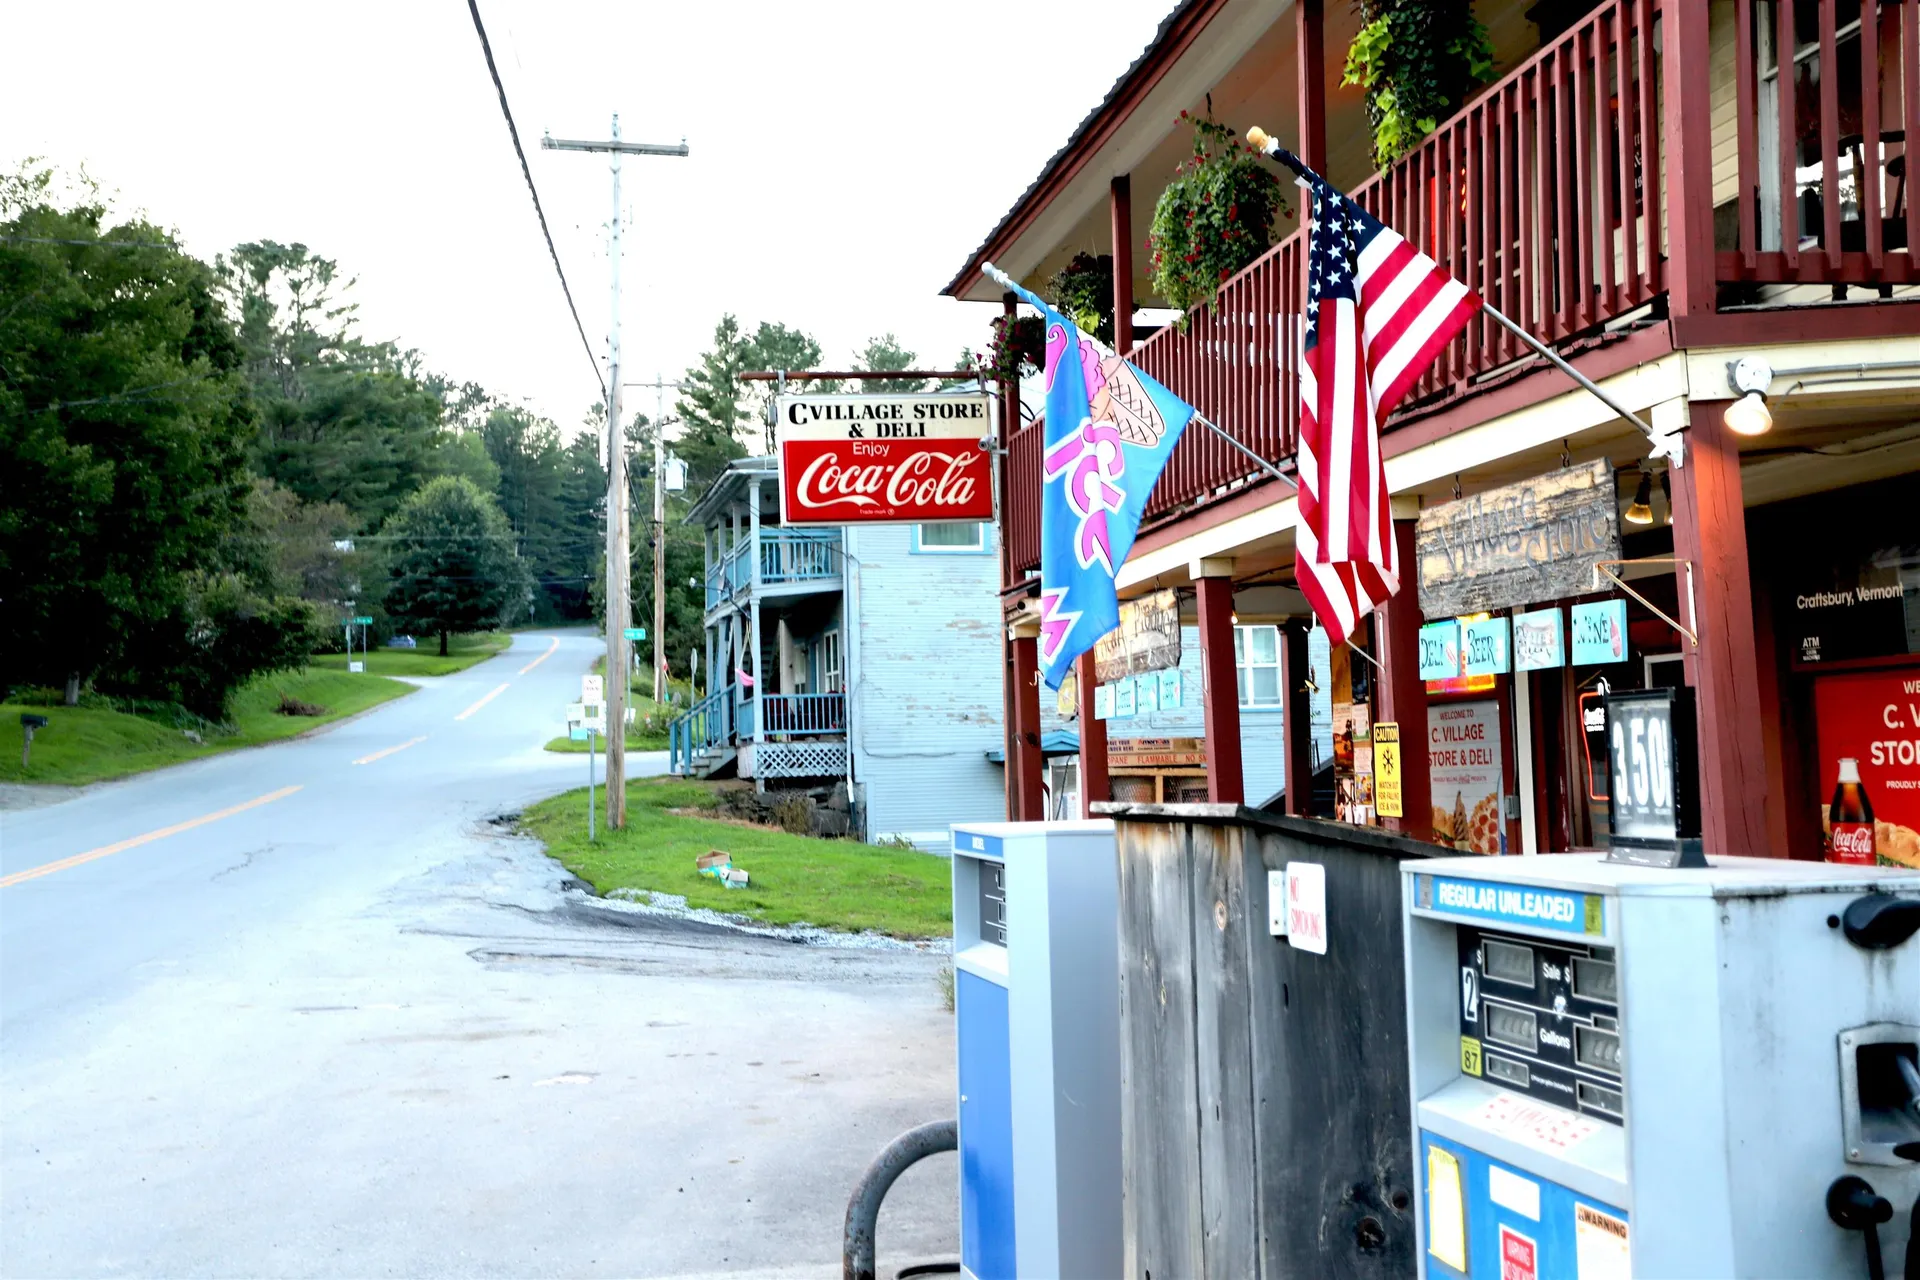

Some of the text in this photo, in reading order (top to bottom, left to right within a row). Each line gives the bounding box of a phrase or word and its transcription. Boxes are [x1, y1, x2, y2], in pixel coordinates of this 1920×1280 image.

[913, 403, 983, 419] STORE
[848, 422, 926, 438] & DELI
[853, 441, 889, 457] Enjoy
[796, 450, 981, 508] Coca-Cola
[1797, 582, 1904, 609] Craftsbury, Vermont
[1466, 628, 1496, 666] BEER
[1803, 636, 1820, 648] ATM
[1440, 711, 1465, 720] WELCOME
[1883, 704, 1905, 729] C.
[1375, 727, 1398, 741] CAUTION
[1431, 724, 1485, 743] C. VILLAGE
[1137, 753, 1178, 764] FLAMMABLE
[1186, 753, 1196, 763] NO
[1428, 748, 1492, 767] STORE & DELI
[1886, 780, 1917, 789] PROUDLY
[1290, 875, 1299, 902] NO
[1439, 882, 1497, 912] REGULAR
[1498, 890, 1576, 923] UNLEADED
[1291, 907, 1322, 940] SMOKING
[1542, 962, 1562, 981] Sale
[1465, 970, 1477, 1017] 2
[1539, 1027, 1571, 1050] Gallons
[1464, 1050, 1478, 1071] 87
[1584, 1208, 1627, 1239] WARNING
